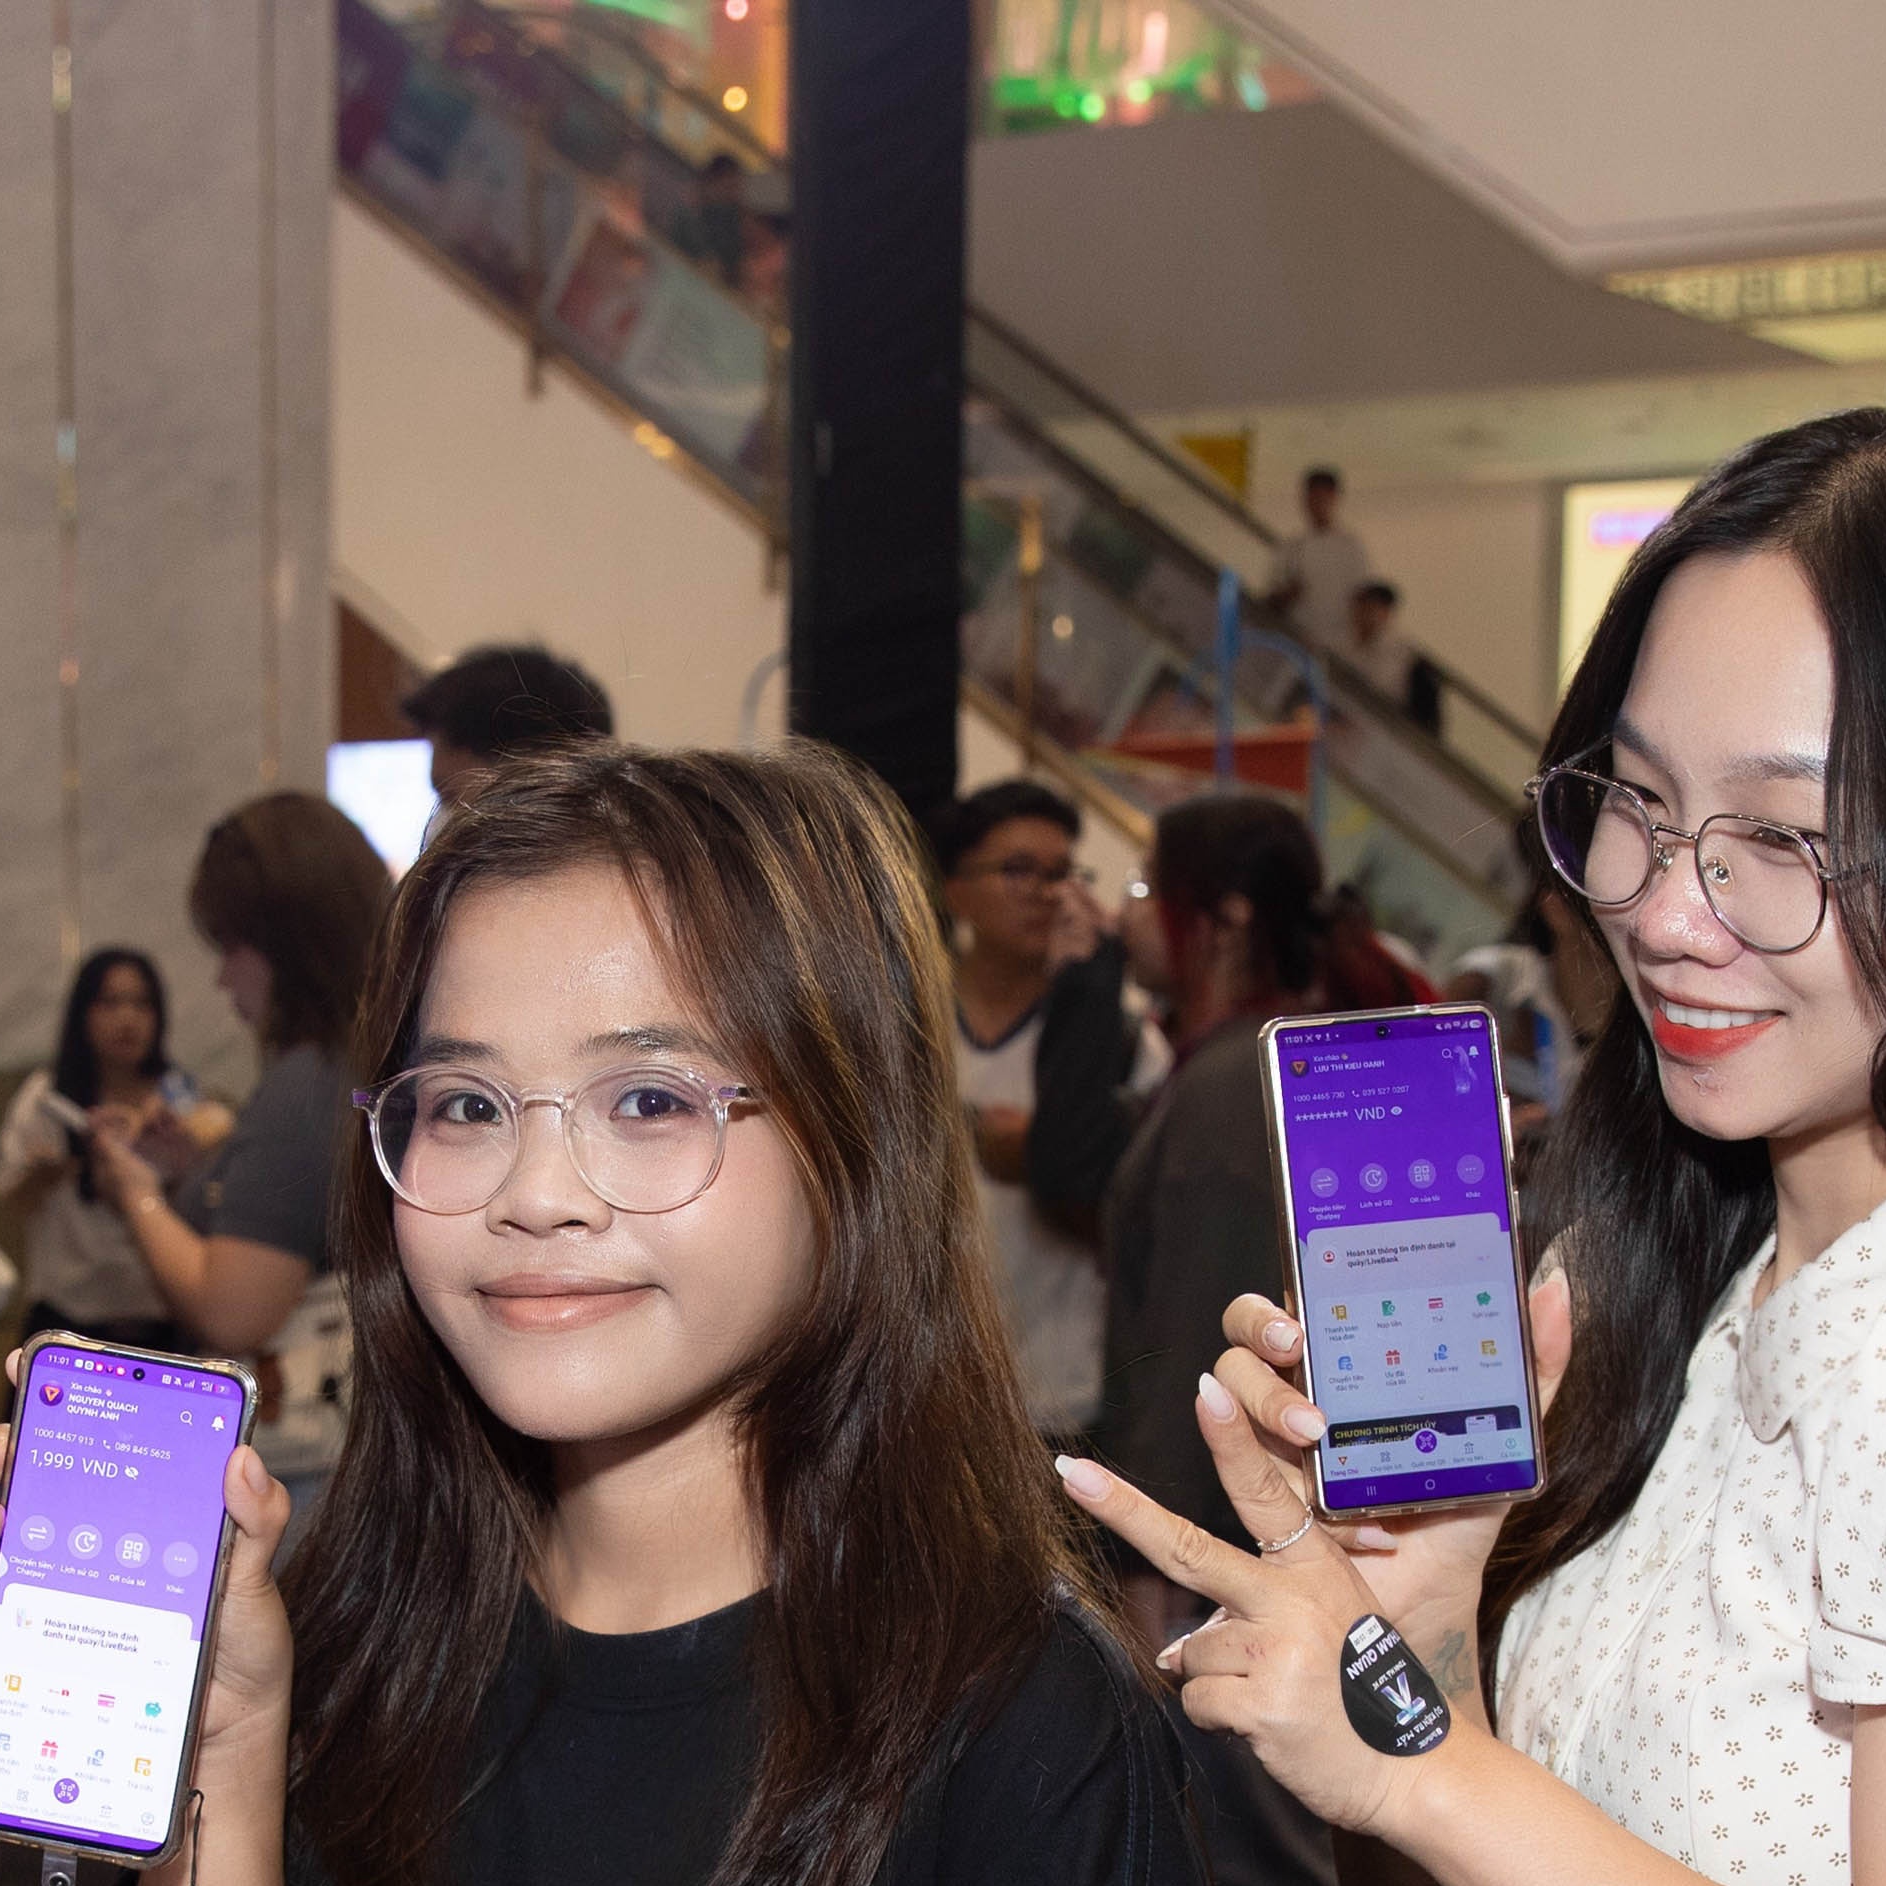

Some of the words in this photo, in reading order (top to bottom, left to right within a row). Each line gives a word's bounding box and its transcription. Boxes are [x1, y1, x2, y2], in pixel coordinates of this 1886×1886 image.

[1285, 1036, 1303, 1044] 11:01
[1330, 1063, 1344, 1071] THI
[1345, 1062, 1362, 1070] KIEU
[1354, 1106, 1385, 1121] VND
[47, 1354, 70, 1365] 11:01
[70, 1381, 83, 1391] Xin
[84, 1384, 102, 1395] chào
[68, 1394, 105, 1407] NGUYEN
[106, 1400, 138, 1413] QUACH
[66, 1404, 99, 1417] QUYNH
[99, 1410, 120, 1422] ANH
[34, 1427, 54, 1438] 1000
[56, 1431, 77, 1442] 4457
[78, 1435, 94, 1447] 913
[114, 1441, 130, 1453] 089
[132, 1444, 149, 1457] 845
[150, 1448, 171, 1460] 5625
[30, 1449, 74, 1470] 1,999
[81, 1457, 118, 1478] VND
[1346, 1648, 1378, 1680] QUAN
